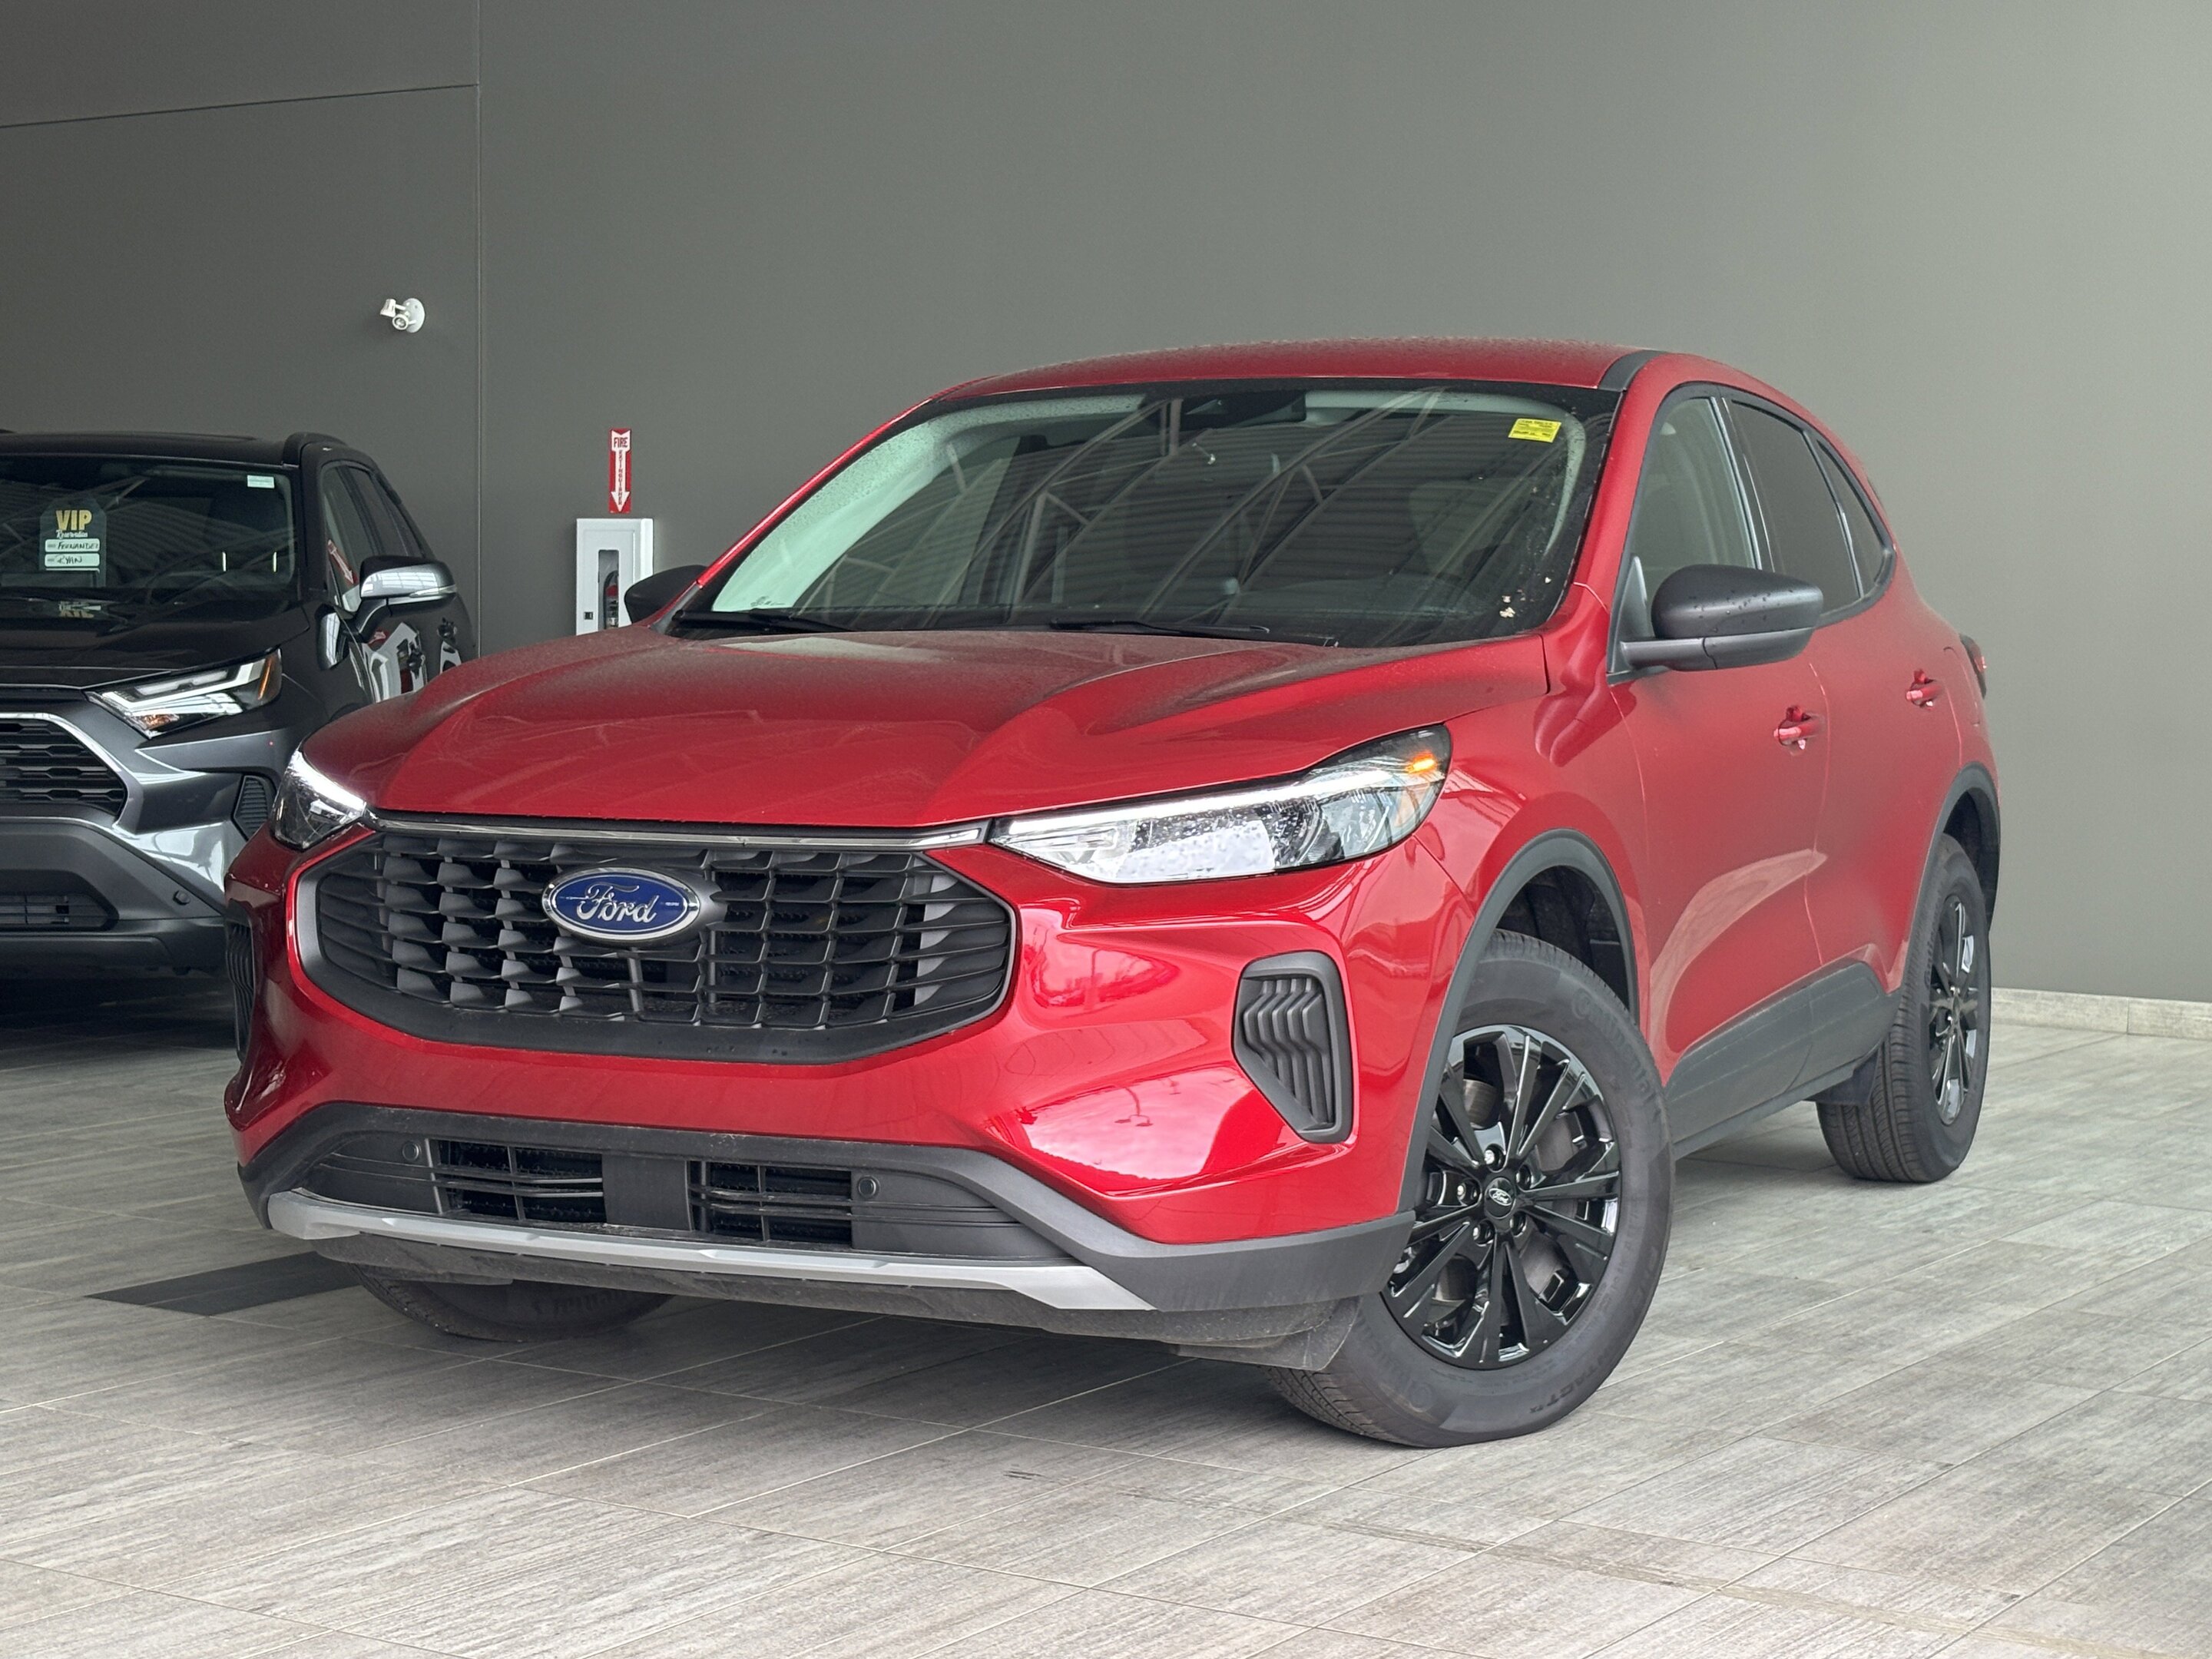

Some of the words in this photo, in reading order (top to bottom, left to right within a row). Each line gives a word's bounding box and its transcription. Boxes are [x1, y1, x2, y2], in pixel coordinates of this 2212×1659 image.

[614, 436, 628, 449] FIRE
[55, 509, 92, 531] VIP
[576, 882, 660, 923] Ford
